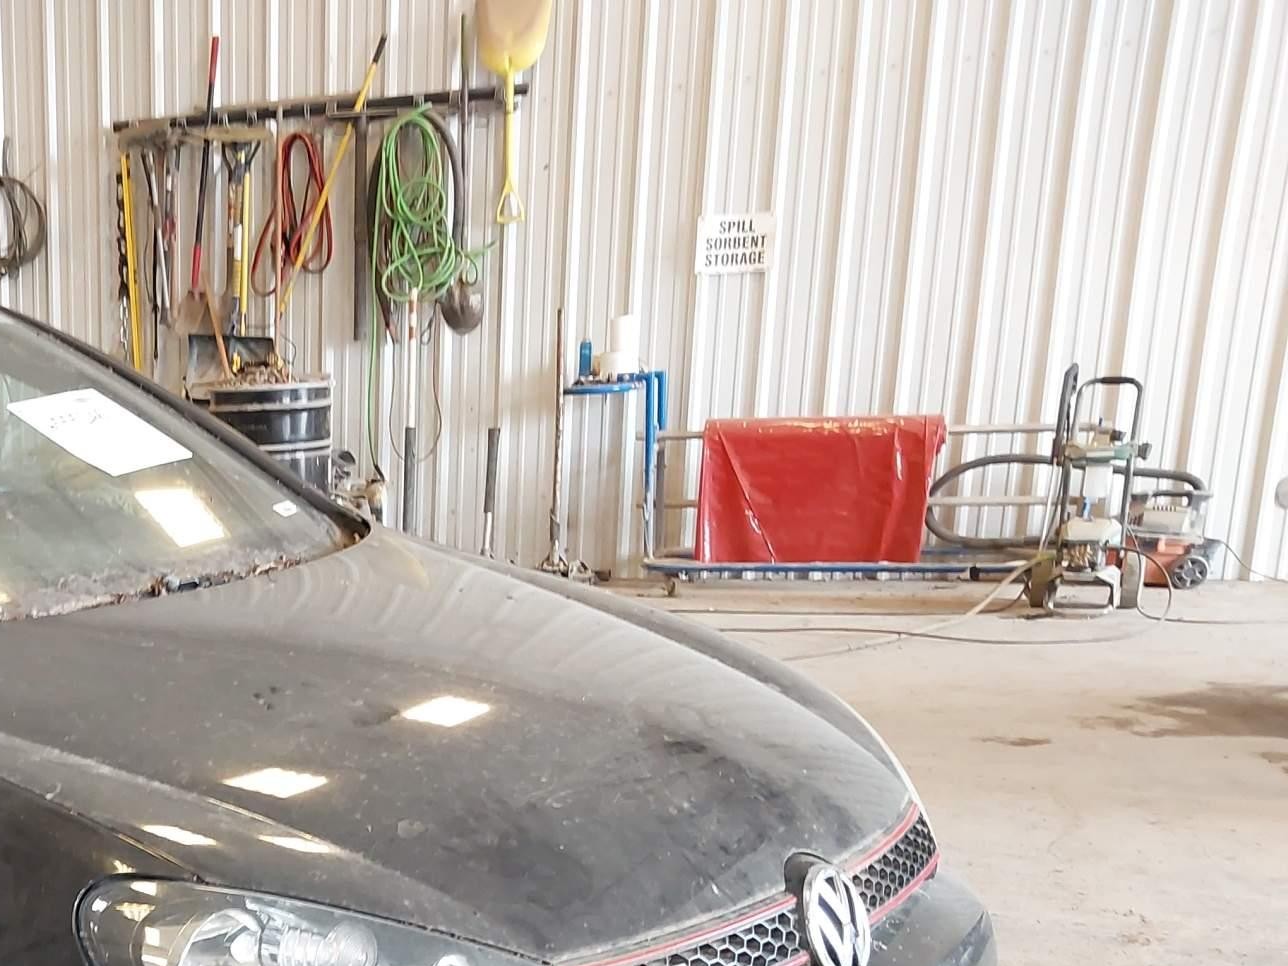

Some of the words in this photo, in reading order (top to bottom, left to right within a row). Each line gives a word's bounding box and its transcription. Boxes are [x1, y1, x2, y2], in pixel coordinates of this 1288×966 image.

[719, 219, 755, 234] SPILL
[706, 234, 766, 251] SORBENT
[705, 250, 765, 267] STORAGE
